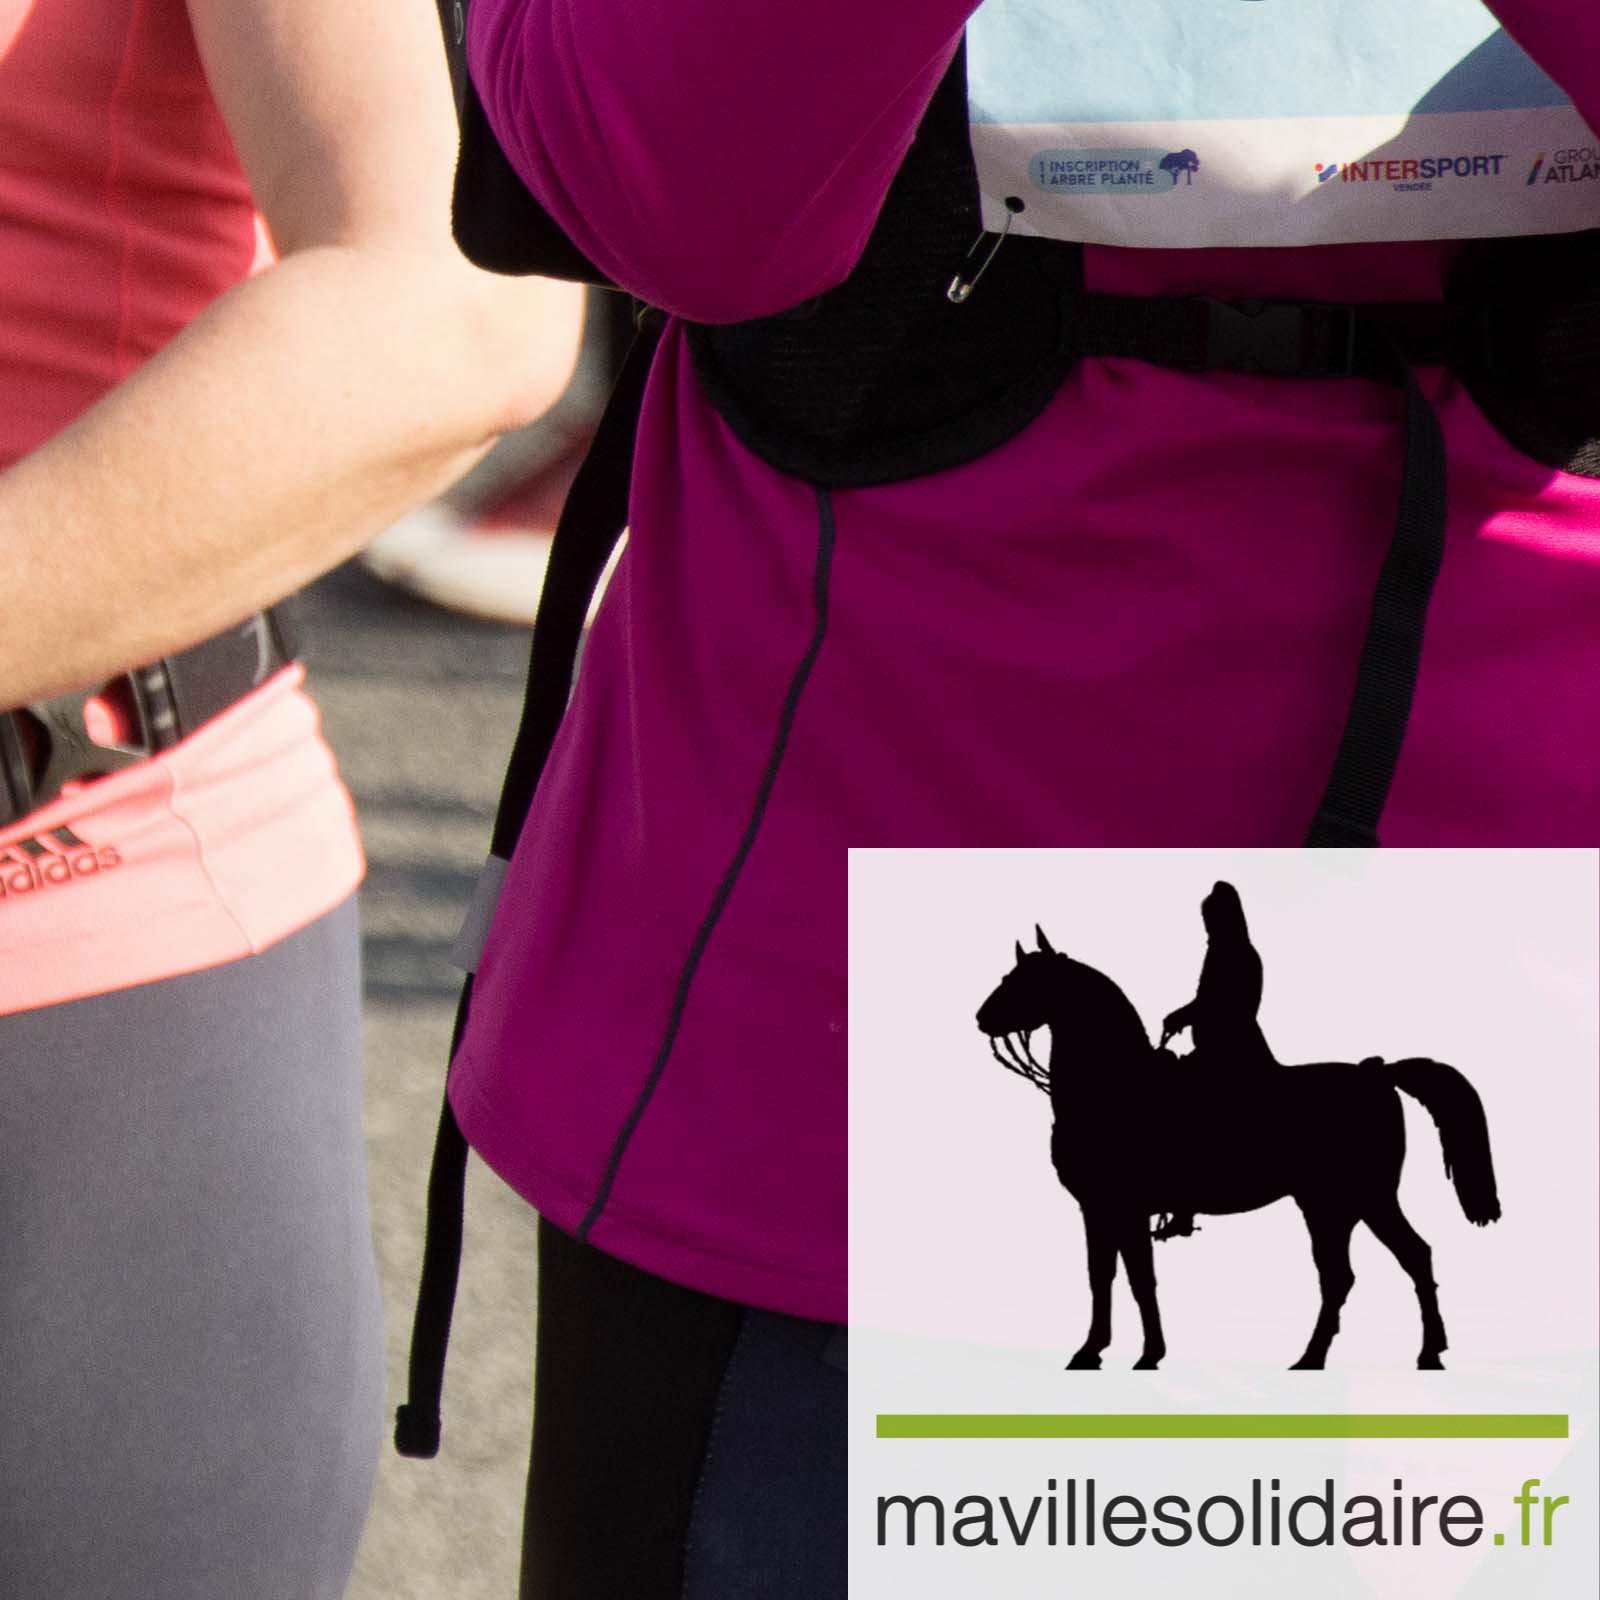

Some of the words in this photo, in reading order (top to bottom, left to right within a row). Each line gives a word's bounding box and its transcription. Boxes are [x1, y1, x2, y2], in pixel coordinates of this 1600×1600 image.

[1050, 160, 1140, 173] INSCRIPTION
[1342, 155, 1505, 183] INTERSPORT
[1050, 173, 1097, 186] ARBRE
[1101, 169, 1155, 186] PLANTÉ
